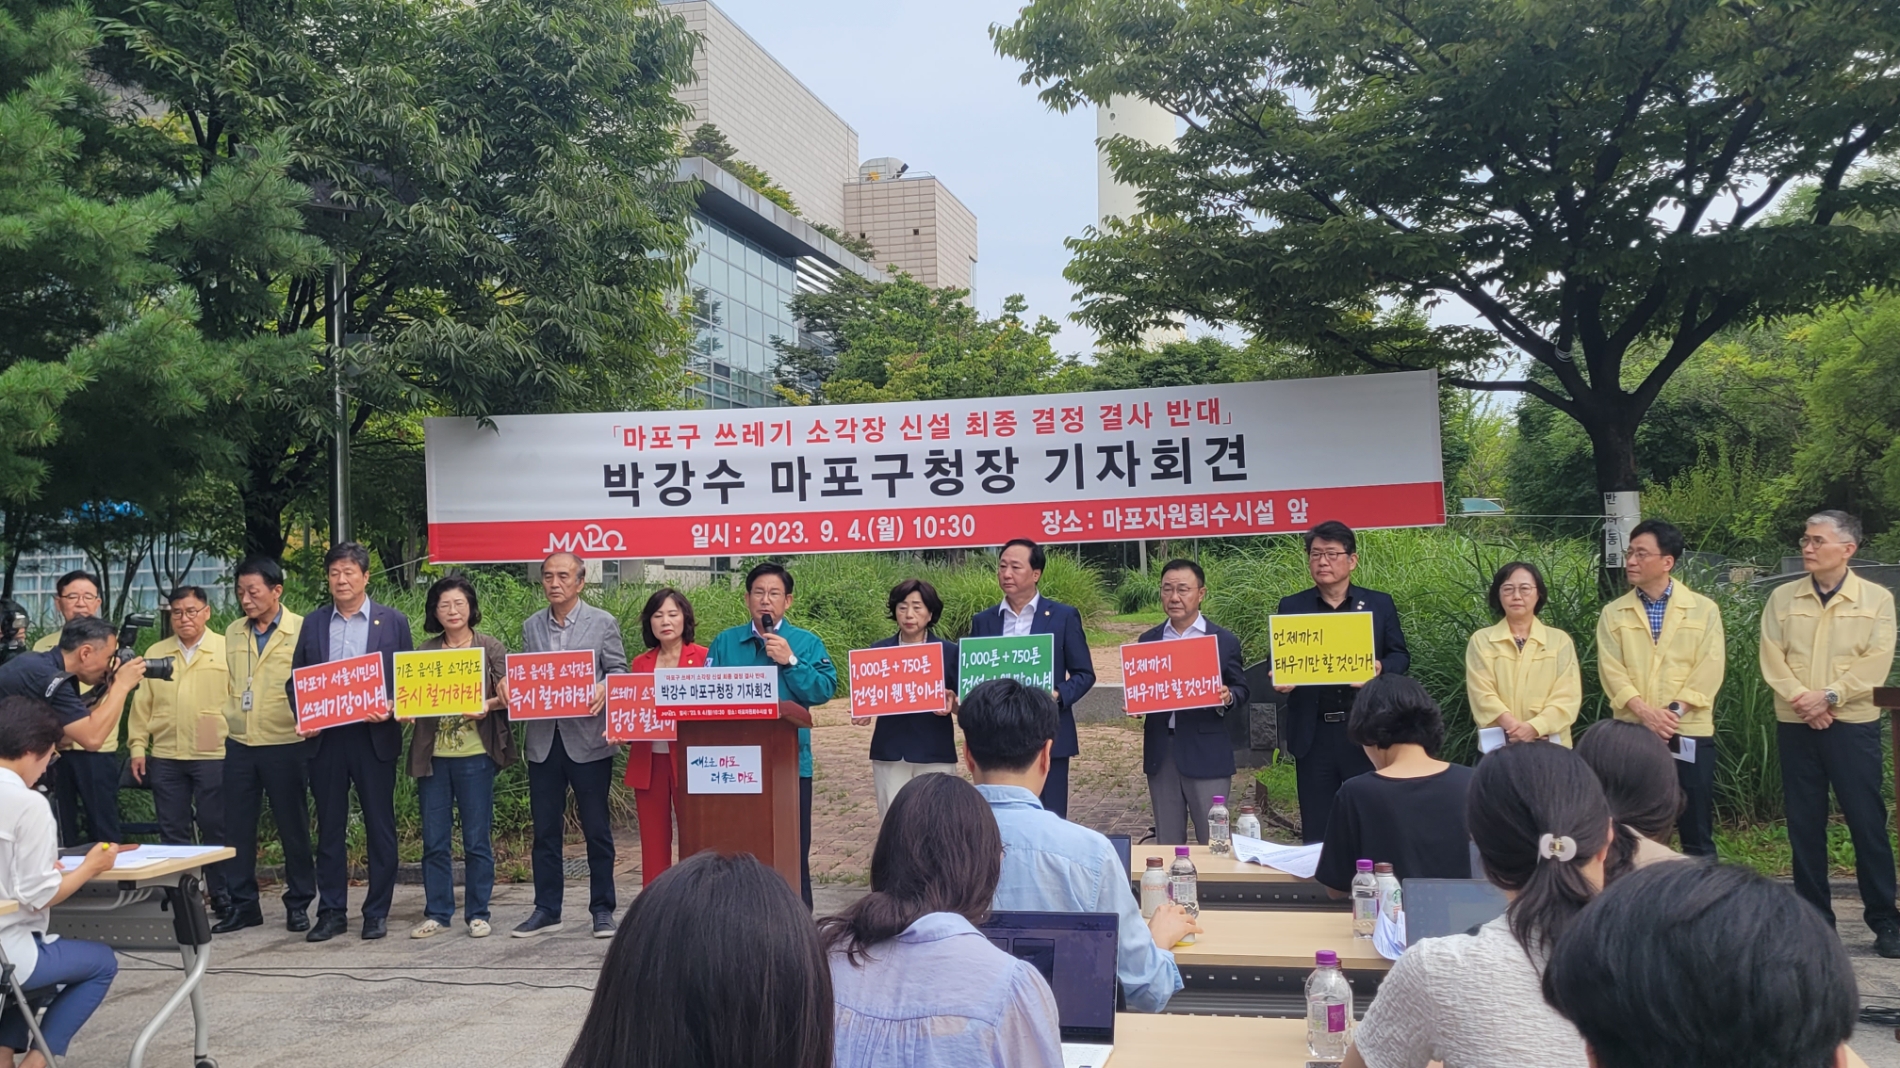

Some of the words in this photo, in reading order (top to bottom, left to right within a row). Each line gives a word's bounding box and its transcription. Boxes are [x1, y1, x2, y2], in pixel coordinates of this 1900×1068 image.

[714, 420, 793, 448] 쓰레기
[806, 415, 886, 445] 소각장
[899, 411, 952, 442] 신설
[965, 408, 1018, 438] 최종
[1031, 405, 1085, 435] 결정
[1099, 401, 1153, 432] 결사
[602, 459, 746, 508] 박강수
[771, 445, 1020, 502] 마포구청장
[1044, 433, 1248, 490] 기자회견
[750, 521, 809, 546] 2023.
[821, 518, 839, 543] 9.
[912, 513, 976, 538] 10:30
[1102, 498, 1275, 533] 마포자원회수시설
[1287, 498, 1309, 525] 앞
[1273, 628, 1323, 647] 언제까지
[396, 662, 414, 678] 기존
[417, 660, 444, 678] 음식물
[447, 659, 482, 676] 소각장도
[851, 658, 891, 681] 1,000톤
[901, 655, 932, 674] 750톤
[961, 648, 1000, 669] 1,000톤
[1012, 646, 1041, 666] 750톤
[1124, 654, 1172, 677] 언제까지
[297, 672, 328, 693] 마포가
[331, 662, 379, 686] 서울시민의
[509, 664, 526, 681] 기존
[529, 662, 555, 680] 음식물
[559, 661, 594, 679] 소각장도
[396, 685, 422, 709] 즉시
[426, 681, 482, 708] 철거하라!
[509, 687, 535, 712] 즉시
[610, 685, 637, 702] 쓰레기
[661, 684, 687, 700] 박강수
[690, 683, 733, 700] 마포구청장
[737, 682, 772, 699] 기자회견
[853, 684, 888, 707] 건설이
[301, 685, 386, 722] 쓰레기장이냐!
[610, 708, 637, 733] 당장
[719, 756, 740, 769] 마포
[738, 771, 758, 784] 마포
